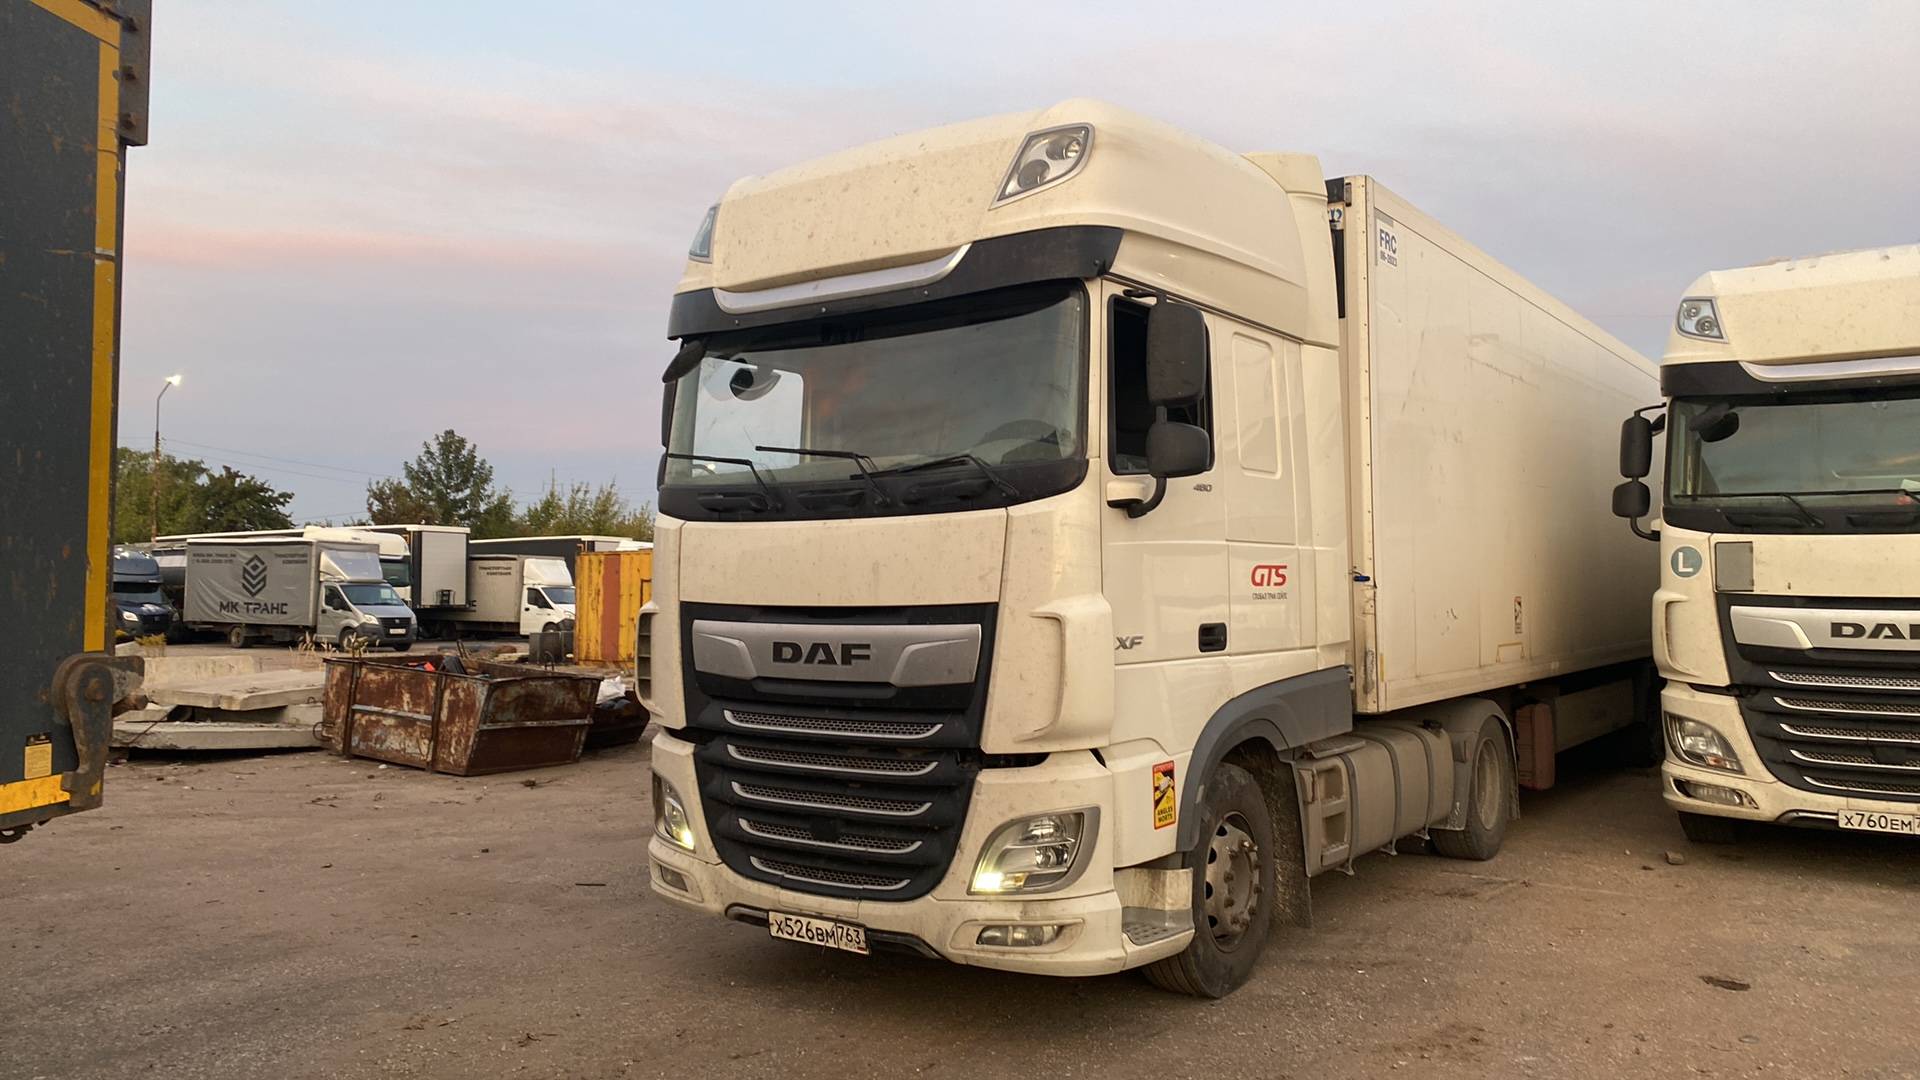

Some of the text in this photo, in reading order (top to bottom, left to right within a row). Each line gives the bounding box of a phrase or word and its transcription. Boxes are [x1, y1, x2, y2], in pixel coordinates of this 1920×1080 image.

[1380, 228, 1397, 254] FRC
[1193, 484, 1212, 492] 480
[1678, 552, 1693, 572] L
[1251, 565, 1288, 587] GTS
[220, 601, 288, 615] МК ТРАНС
[1115, 636, 1143, 649] XF
[773, 642, 871, 666] DAF
[837, 926, 861, 944] 763
